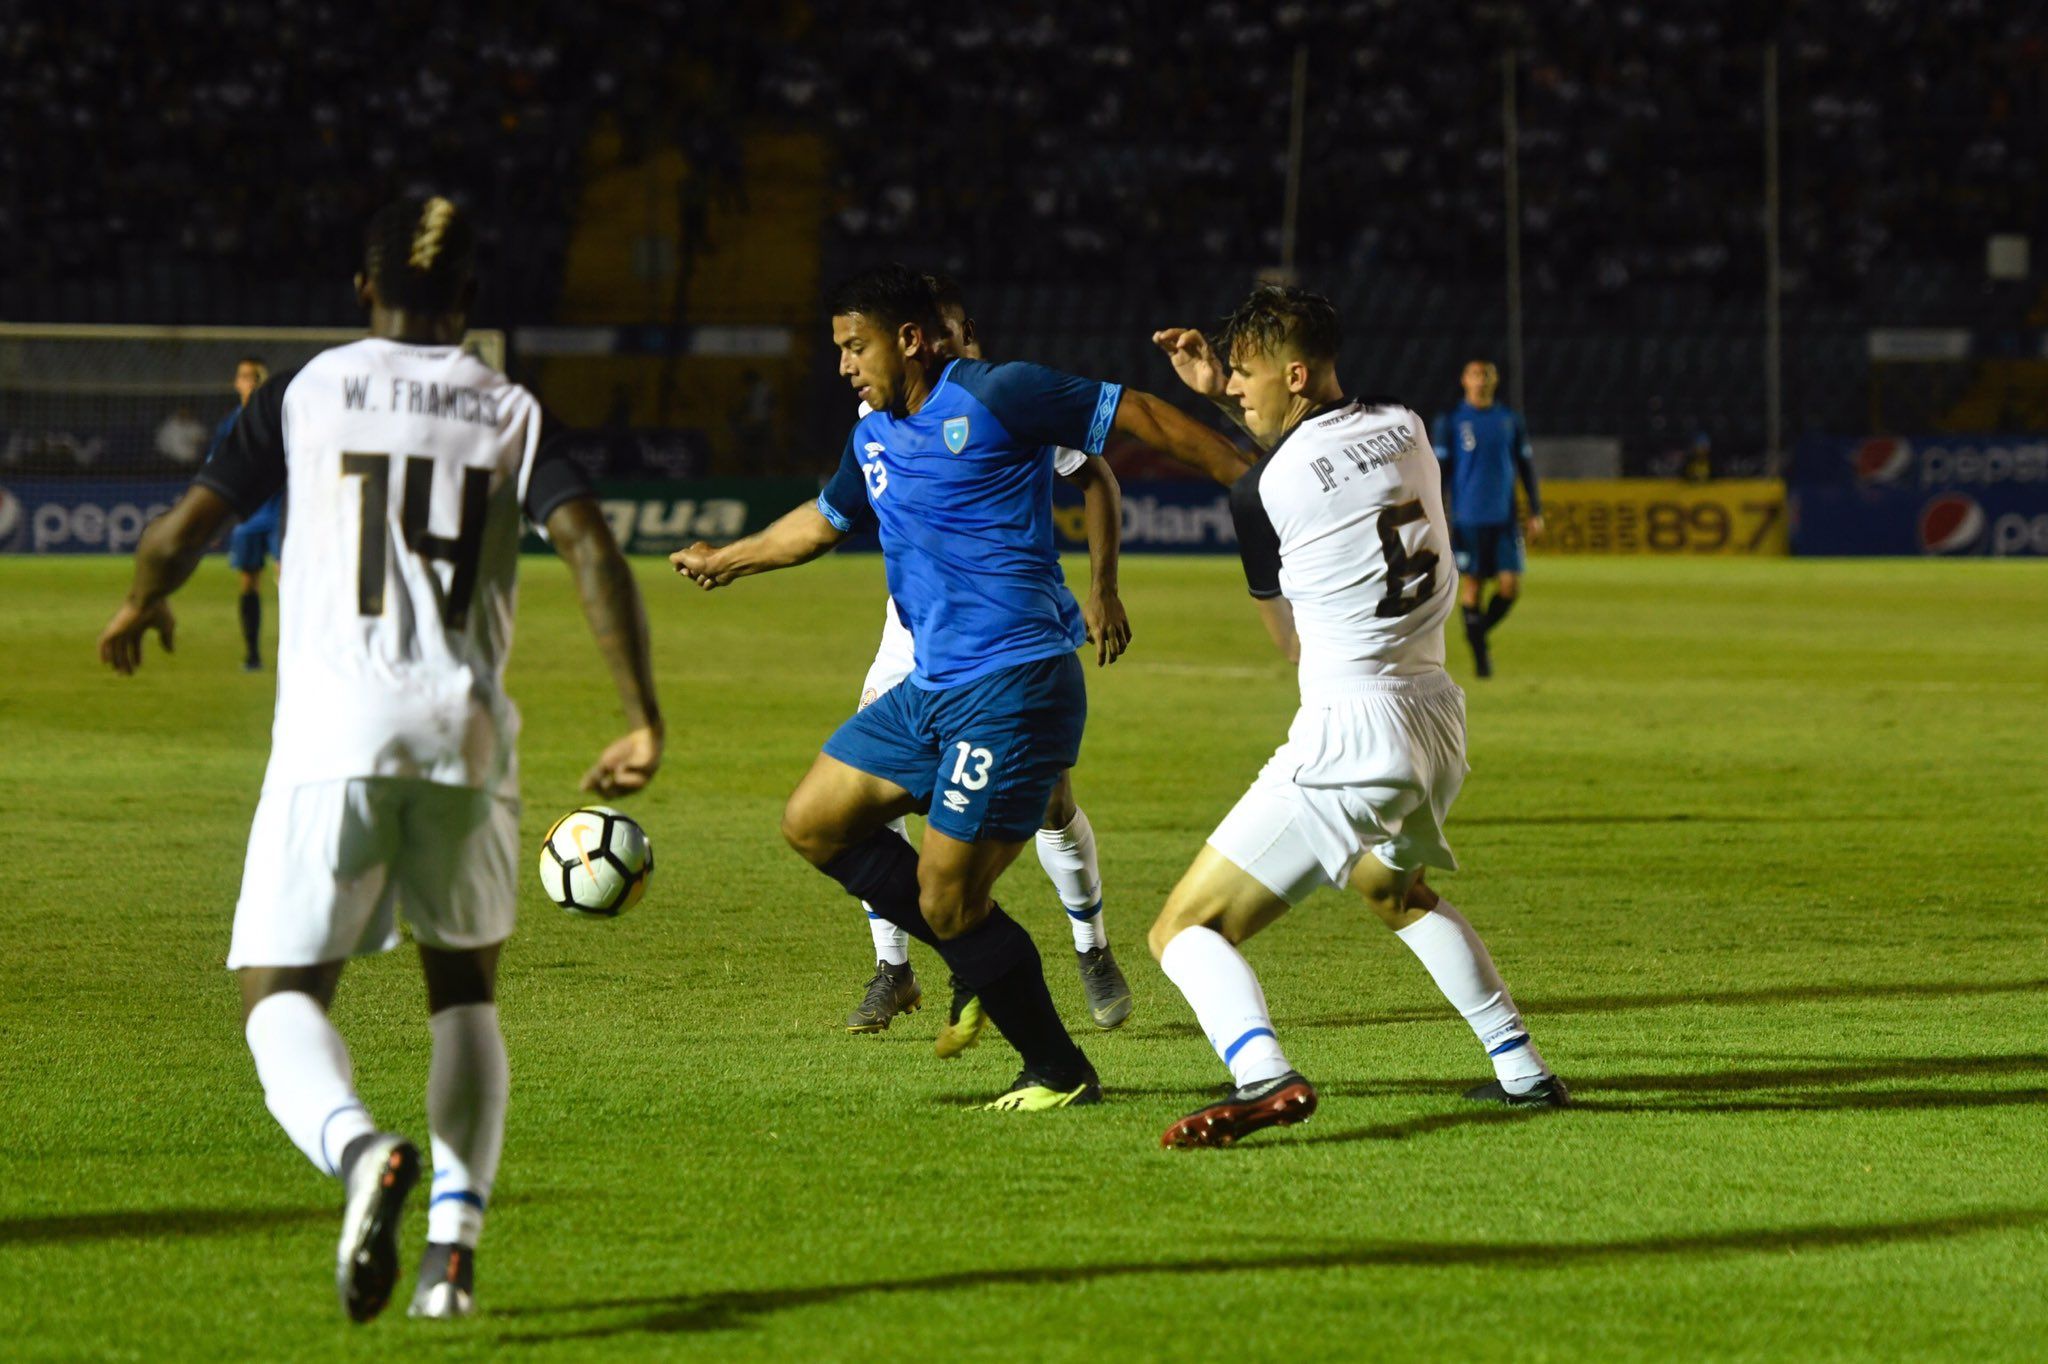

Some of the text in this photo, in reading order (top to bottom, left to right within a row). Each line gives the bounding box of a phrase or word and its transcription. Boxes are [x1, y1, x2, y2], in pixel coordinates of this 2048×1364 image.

[1342, 425, 1417, 475] VARGAS
[339, 453, 495, 630] 14
[1374, 498, 1440, 618] 6
[951, 741, 993, 791] 13
